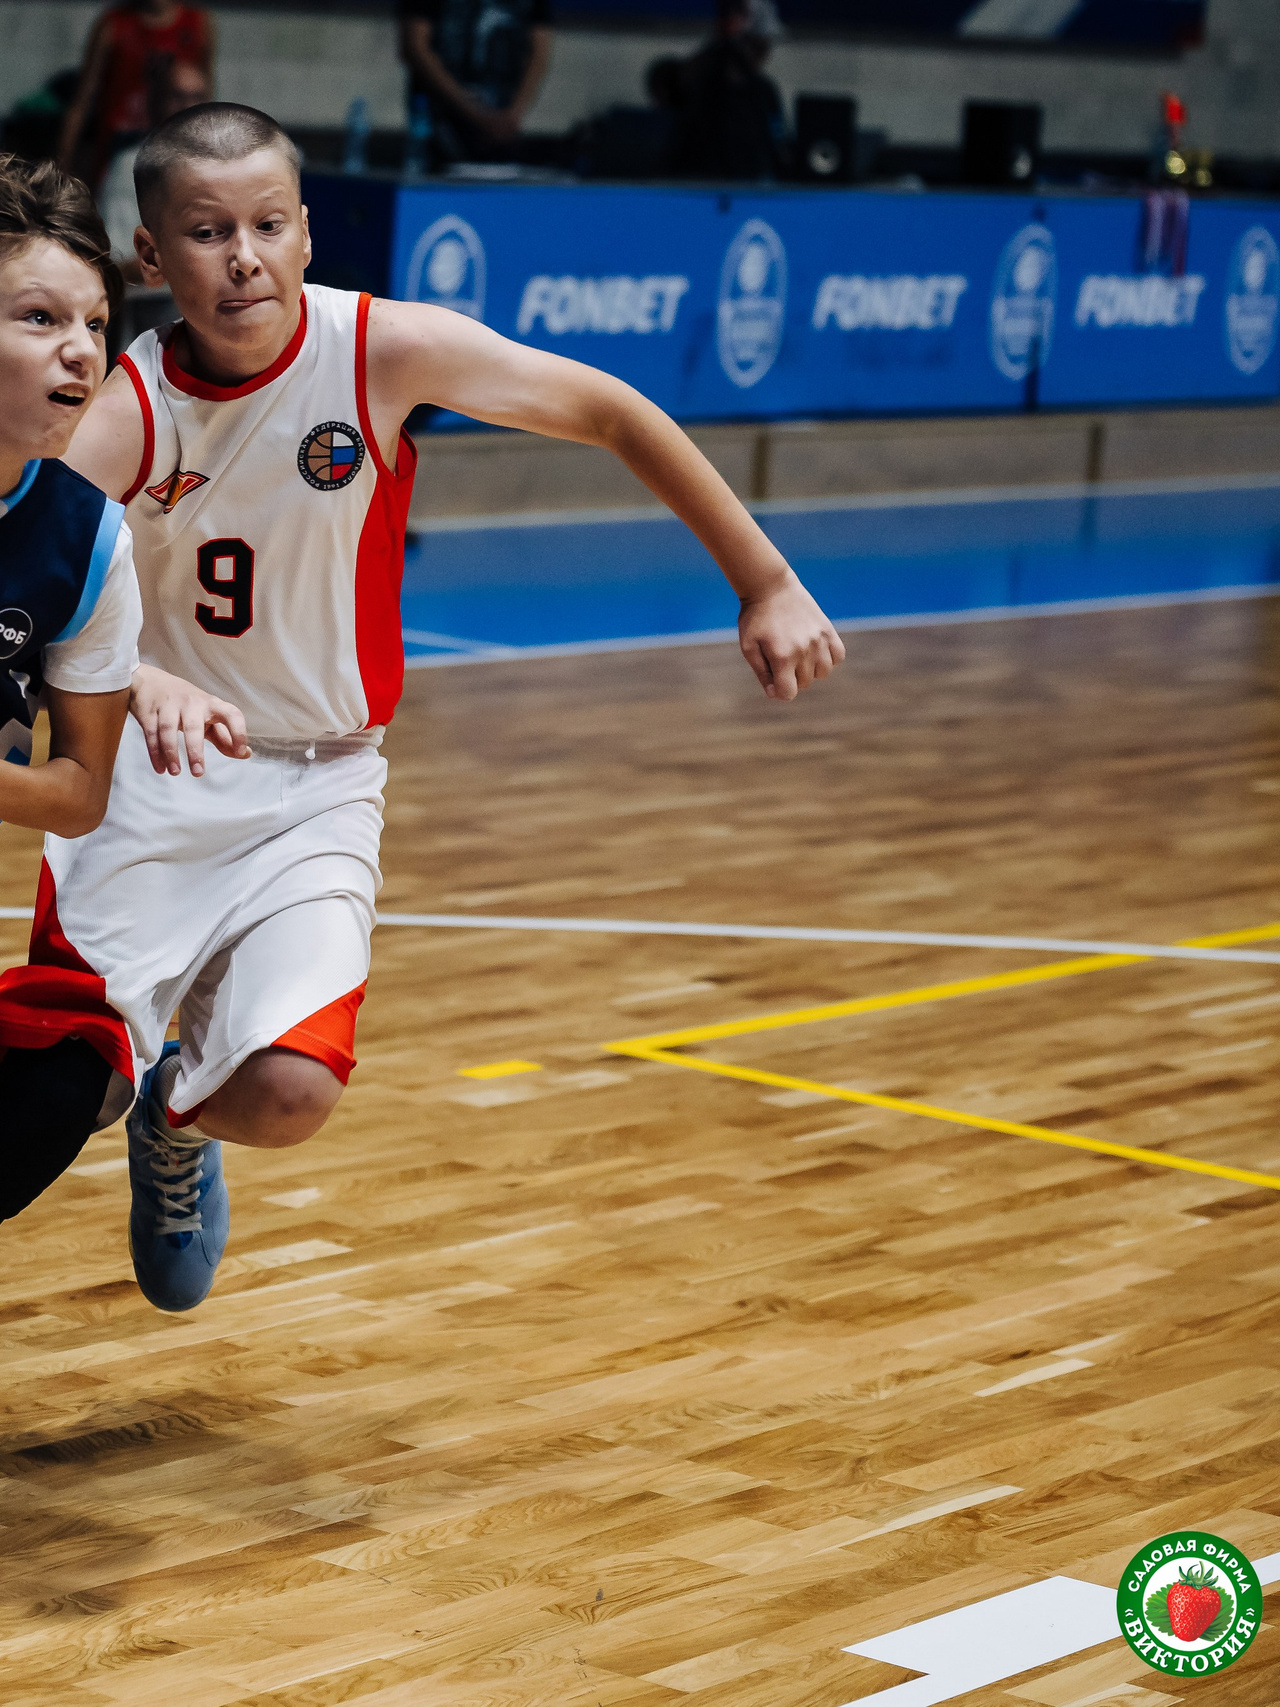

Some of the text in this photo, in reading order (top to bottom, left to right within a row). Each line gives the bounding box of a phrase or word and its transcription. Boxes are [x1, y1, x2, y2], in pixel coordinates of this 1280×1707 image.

[517, 274, 690, 336] FONBET
[813, 273, 967, 331] FONBET
[1075, 272, 1205, 328] FONBET
[310, 422, 356, 436] ФЕДЕРАЦИЯ
[195, 537, 255, 638] 9
